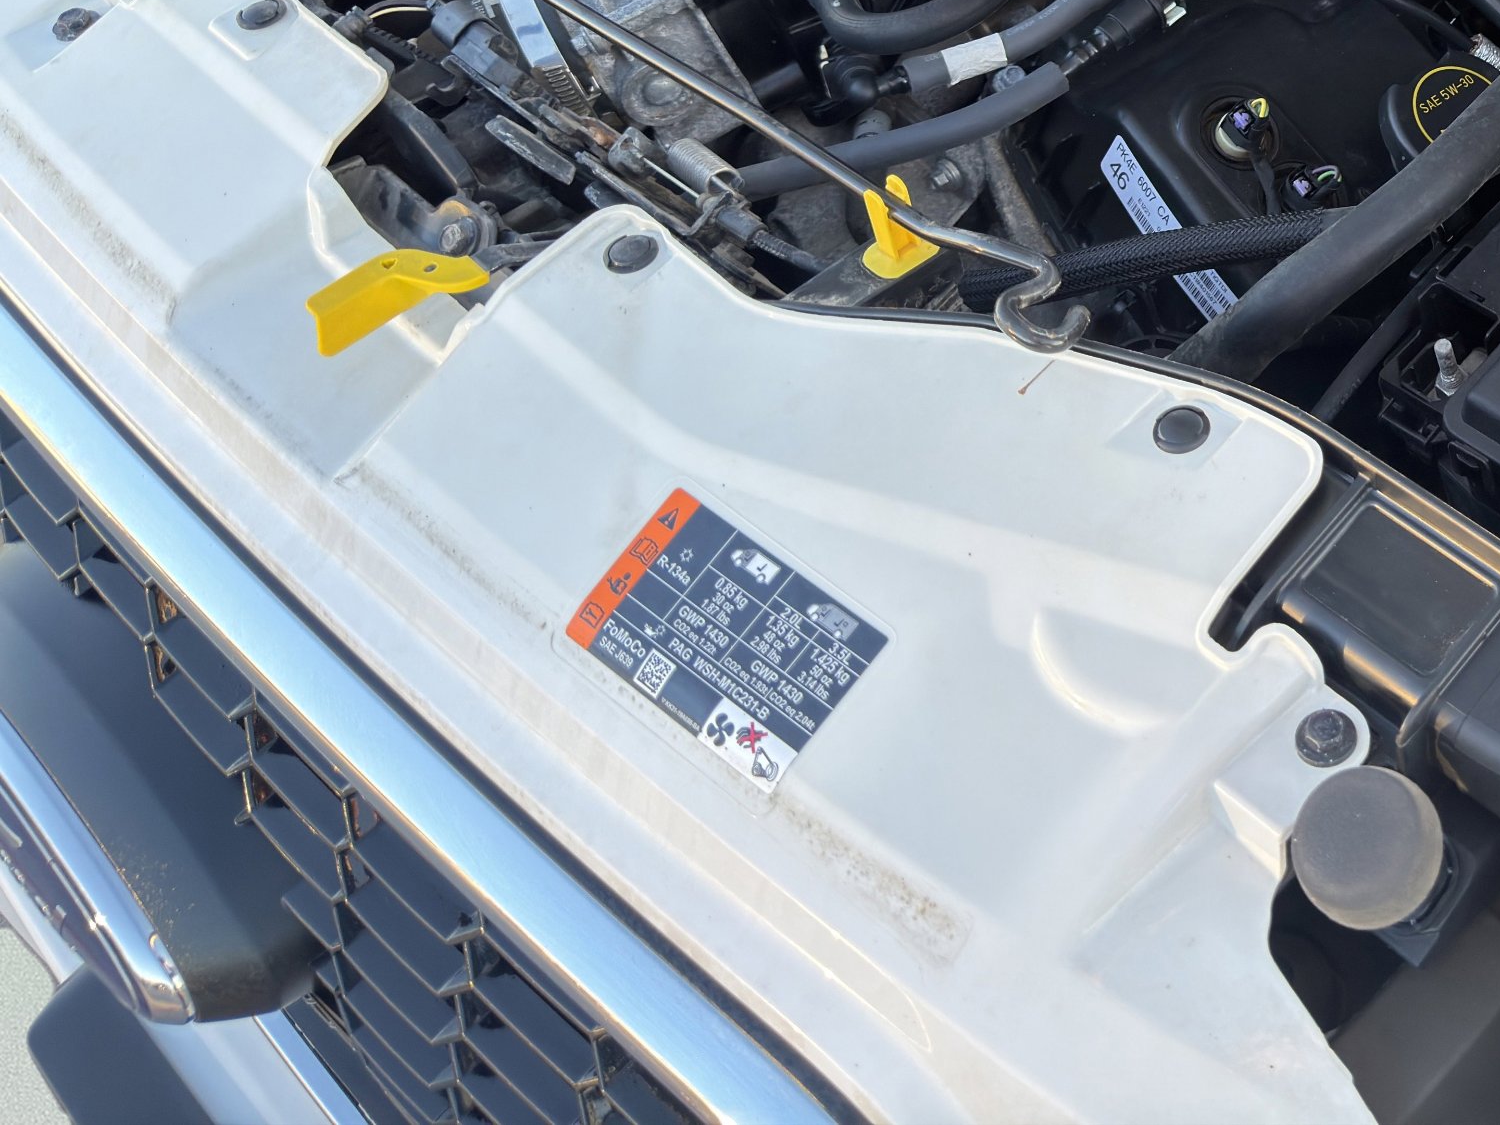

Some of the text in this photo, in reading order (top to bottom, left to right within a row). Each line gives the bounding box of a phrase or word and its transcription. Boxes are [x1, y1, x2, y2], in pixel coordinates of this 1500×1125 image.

[1419, 74, 1475, 114] SAE 5W-30
[1109, 162, 1129, 190] 46
[1115, 142, 1169, 225] PK4E 6007 CA
[656, 553, 690, 585] R-134a
[711, 591, 734, 614] 30 oz
[714, 574, 752, 610] 0.85 kg
[678, 604, 729, 647] GWP 1430
[700, 598, 730, 625] 1.87 lbs
[779, 606, 802, 629] 2.0L
[602, 618, 646, 658] FoMoCo
[672, 618, 716, 655] CO2 eq 1.22t
[762, 630, 785, 652] 48 oz
[765, 614, 801, 648] 1.35 kg
[598, 635, 633, 668] SAE J639
[749, 635, 781, 664] 2.98 lbs
[827, 642, 851, 665] 3.5L
[667, 637, 769, 719] PAG WSH-M1C231-B
[723, 656, 741, 674] CO2
[738, 669, 750, 682] eq
[750, 659, 803, 704] GWP 1430
[808, 664, 833, 687] 50 oz
[810, 647, 850, 686] 1.425 kg
[796, 670, 829, 700] 3.14 lbs
[768, 691, 815, 730] CO2 eq 2.04t
